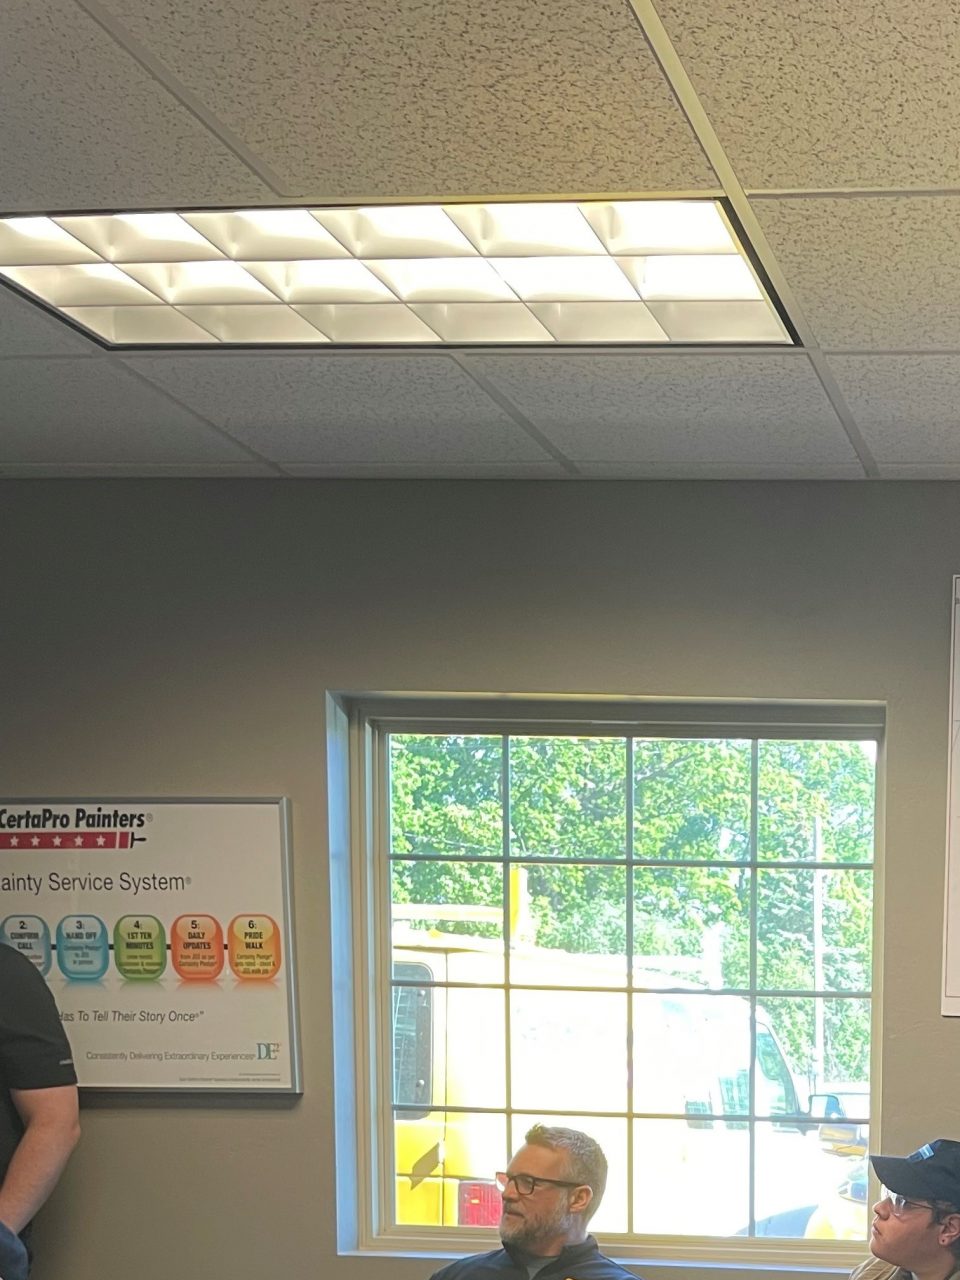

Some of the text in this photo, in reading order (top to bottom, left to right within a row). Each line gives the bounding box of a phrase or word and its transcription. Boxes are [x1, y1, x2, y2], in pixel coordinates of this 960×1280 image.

[0, 808, 70, 829] CertaPro
[48, 872, 114, 891] Service
[248, 920, 257, 929] 6:
[188, 932, 206, 940] DAILY
[244, 932, 263, 940] PRIDE
[183, 942, 211, 950] UPDATES
[245, 941, 263, 950] WALK
[78, 1010, 90, 1022] To
[93, 1010, 109, 1022] Tell
[112, 1010, 136, 1022] Their
[138, 1010, 165, 1024] Story
[130, 1051, 163, 1062] Delivering
[164, 1051, 210, 1062] Extraordinary
